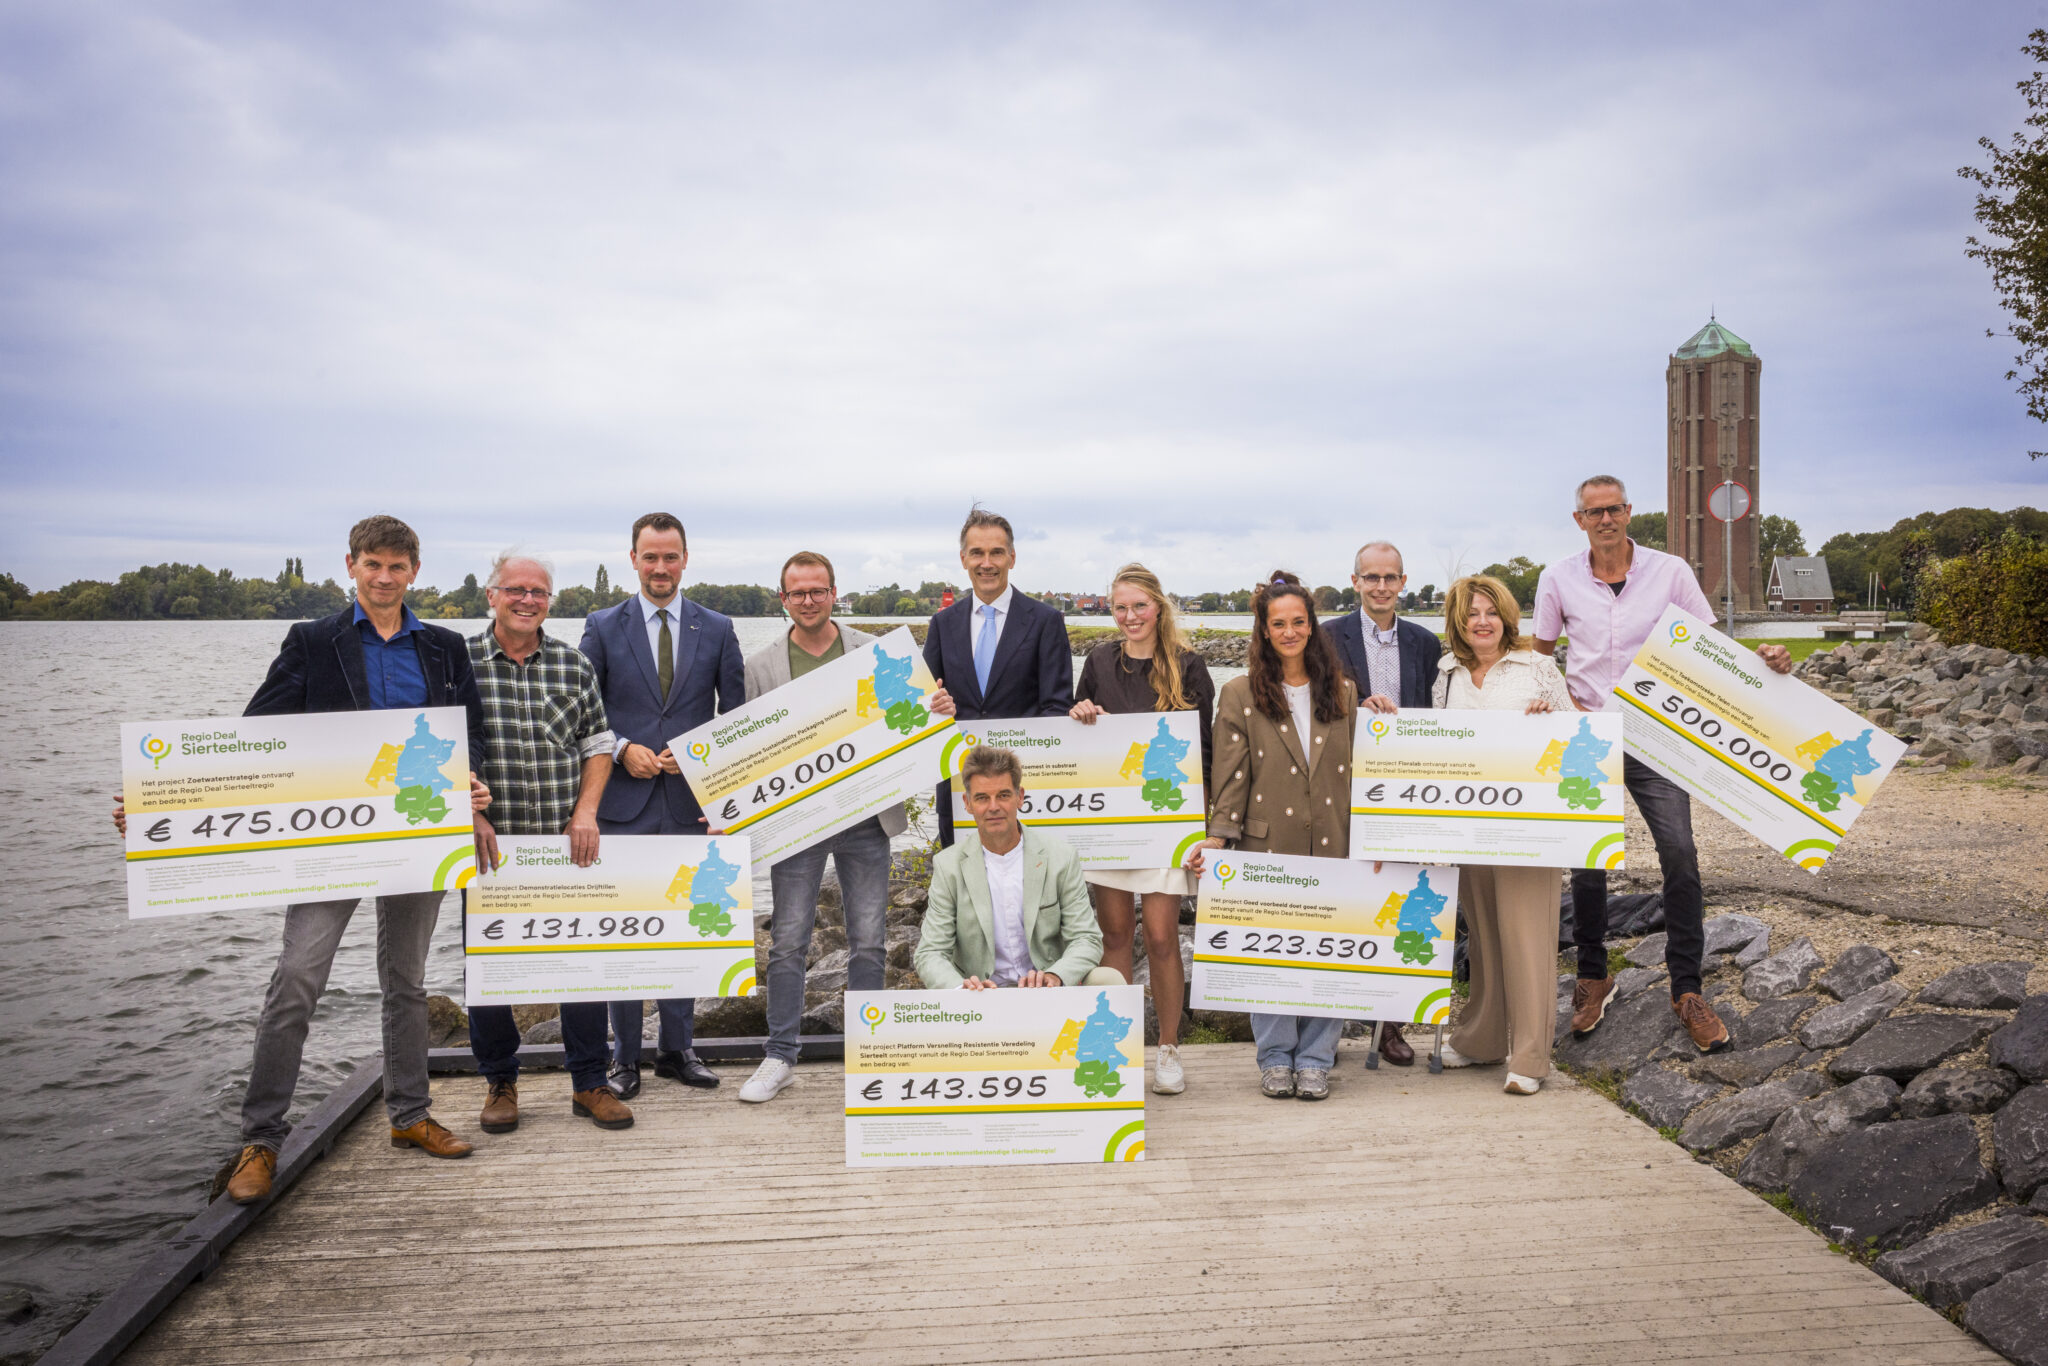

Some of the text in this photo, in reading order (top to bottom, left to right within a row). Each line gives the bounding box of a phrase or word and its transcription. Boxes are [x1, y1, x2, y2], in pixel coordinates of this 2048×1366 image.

[1698, 633, 1737, 661] Regio Deal
[1692, 641, 1763, 689] Sierteeltregio
[1650, 654, 1754, 721] Het project Toekomstzeker Telen ontvangt
[1646, 661, 1662, 673] vanuit
[1669, 674, 1685, 687] Regio
[1684, 684, 1697, 694] Deal
[1696, 691, 1730, 716] Sierteeltregio
[1730, 713, 1741, 722] een
[1740, 718, 1760, 734] bedrag
[711, 714, 751, 739] Regio Deal
[715, 708, 789, 748] Sierteeltregio
[1396, 717, 1438, 727] Regio Deal
[181, 729, 237, 743] Regio Deal
[986, 728, 1026, 738] Regio Deal
[1395, 725, 1475, 739] Sierteeltregio
[1633, 680, 1656, 697] €
[1661, 694, 1792, 781] 500.000
[181, 737, 287, 755] Sierteeltregio
[700, 708, 847, 783] Het project Horticulture Sustainability Packaging Initiative
[987, 735, 1061, 748] Sierteeltregio
[704, 775, 729, 789] ontvangt
[728, 766, 746, 778] vanuit
[752, 755, 769, 766] Regio
[768, 748, 782, 758] Deal
[781, 731, 818, 751] Sierteeltregio
[157, 778, 185, 787] project
[186, 773, 260, 784] Zoetwaterstrategie
[261, 771, 294, 779] ontvangt
[720, 798, 740, 820] €
[751, 742, 855, 804] 49.000
[141, 781, 274, 796] vanuit de Regio Deal Sierteeltregio
[708, 788, 719, 796] een
[718, 779, 739, 791] bedrag
[1364, 783, 1523, 806] € 40.000
[158, 797, 187, 805] bedrag
[143, 803, 375, 842] € 475.000
[515, 846, 562, 855] Regio Deal
[515, 854, 602, 868] Sierteelto
[1243, 862, 1284, 873] Regio Deal
[1242, 870, 1319, 888] Sierteeltregio
[586, 883, 615, 891] Drijftillen
[576, 891, 619, 899] Sierteeltregio
[494, 901, 518, 909] bedrag
[1209, 905, 1235, 913] ontvangt
[1263, 908, 1280, 916] Regio
[1294, 910, 1332, 920] Sierteeltregio
[1221, 913, 1242, 921] bedrag
[481, 916, 664, 940] € 131.980
[1207, 930, 1378, 960] € 223.530
[893, 1001, 940, 1011] Regio Deal
[893, 1009, 983, 1024] Sierteeltregio
[872, 1043, 895, 1051] project
[1000, 1040, 1035, 1048] Veredeling
[949, 1050, 969, 1058] Regio
[873, 1060, 896, 1068] bedrag
[860, 1075, 1047, 1101] € 143.595
